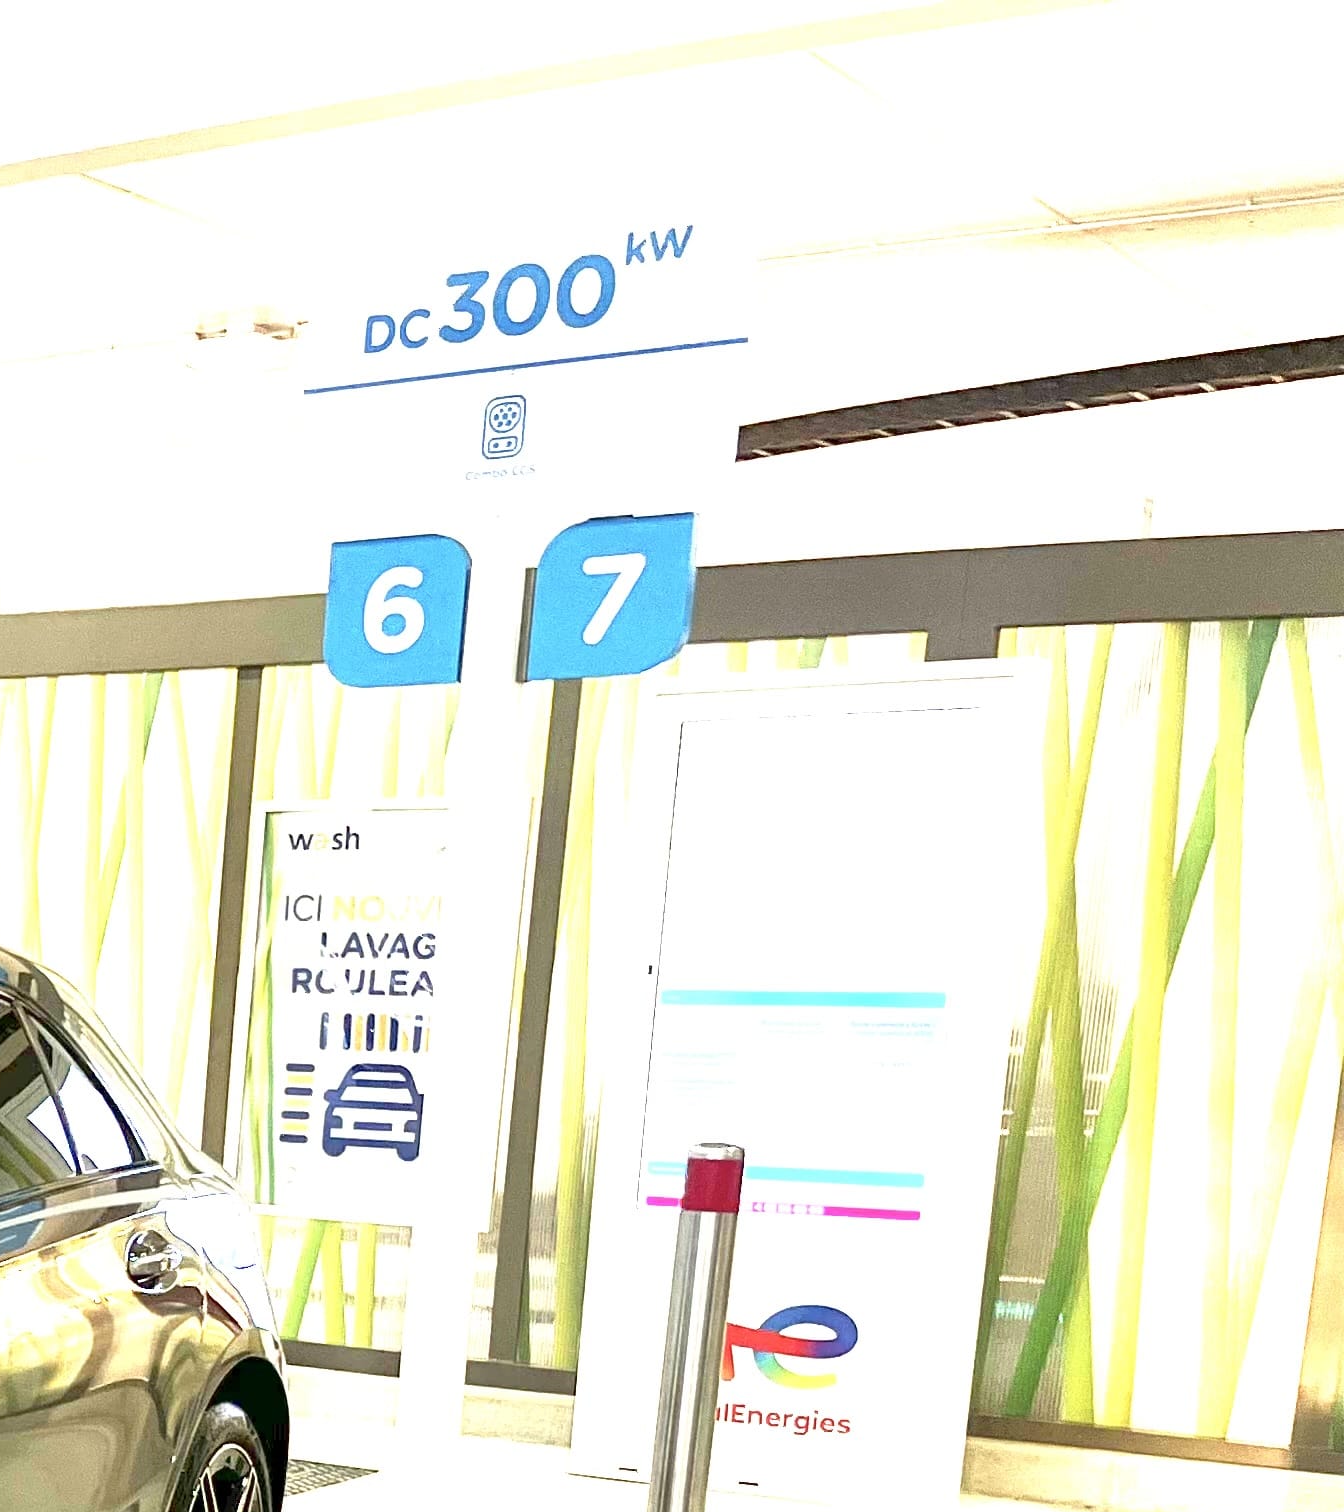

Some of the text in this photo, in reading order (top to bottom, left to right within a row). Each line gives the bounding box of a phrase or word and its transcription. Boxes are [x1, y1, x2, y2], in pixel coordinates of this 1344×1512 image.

[362, 565, 425, 655] 6
[581, 552, 647, 645] 7
[285, 894, 322, 921] ICI
[320, 932, 437, 960] LAVAG
[291, 967, 434, 996] ROULEA
[715, 1403, 851, 1435] lEnergies
